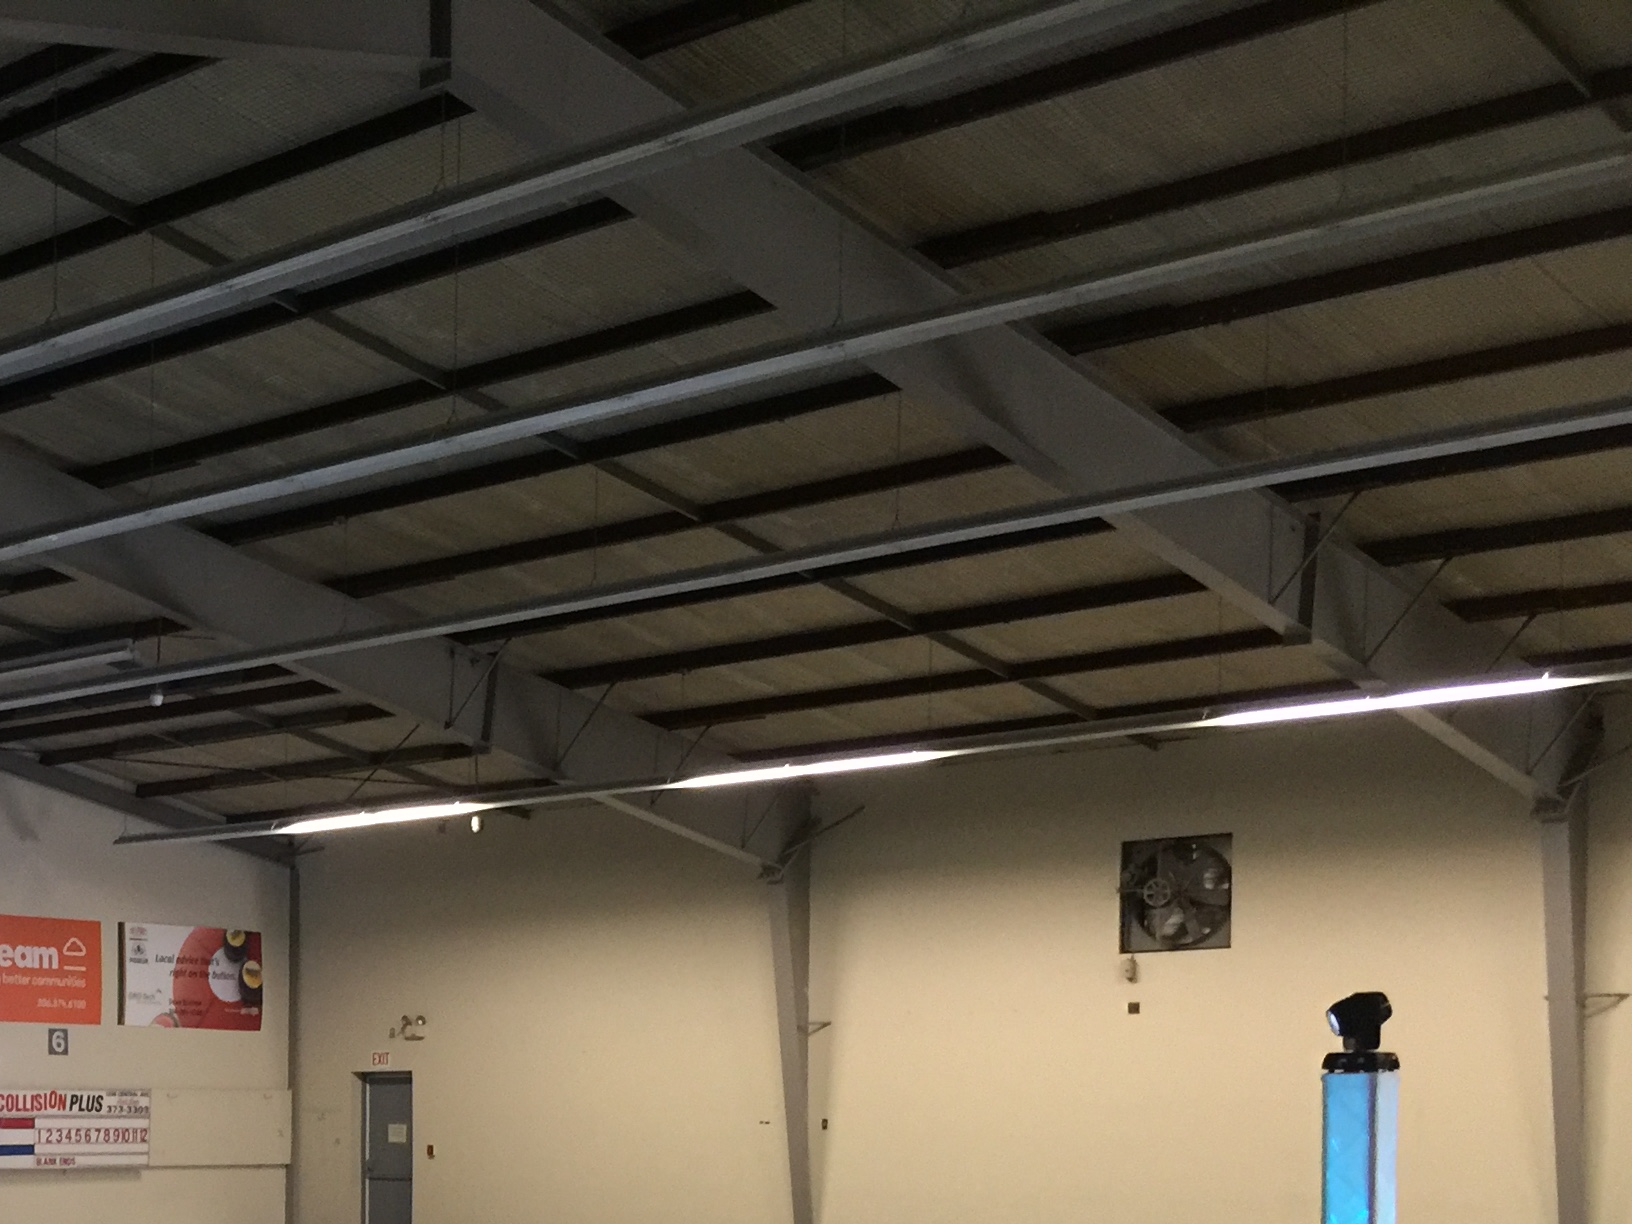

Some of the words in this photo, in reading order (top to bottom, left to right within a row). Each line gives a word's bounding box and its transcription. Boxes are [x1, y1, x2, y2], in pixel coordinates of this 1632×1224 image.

[155, 954, 175, 963] Local
[2, 973, 31, 986] better
[31, 975, 86, 988] communities
[51, 1030, 65, 1053] 6
[372, 1052, 390, 1066] EXIT
[69, 1094, 104, 1112] PLUS
[37, 1128, 41, 1143] 1
[46, 1128, 53, 1143] 2
[55, 1128, 63, 1143] 3
[65, 1128, 72, 1143] 4
[75, 1128, 82, 1143] 5
[84, 1128, 91, 1143] 6
[94, 1128, 101, 1143] 7
[103, 1128, 110, 1143] 8
[113, 1128, 120, 1143] 9
[121, 1128, 130, 1143] 10
[132, 1128, 138, 1143] 11
[139, 1128, 148, 1143] 12
